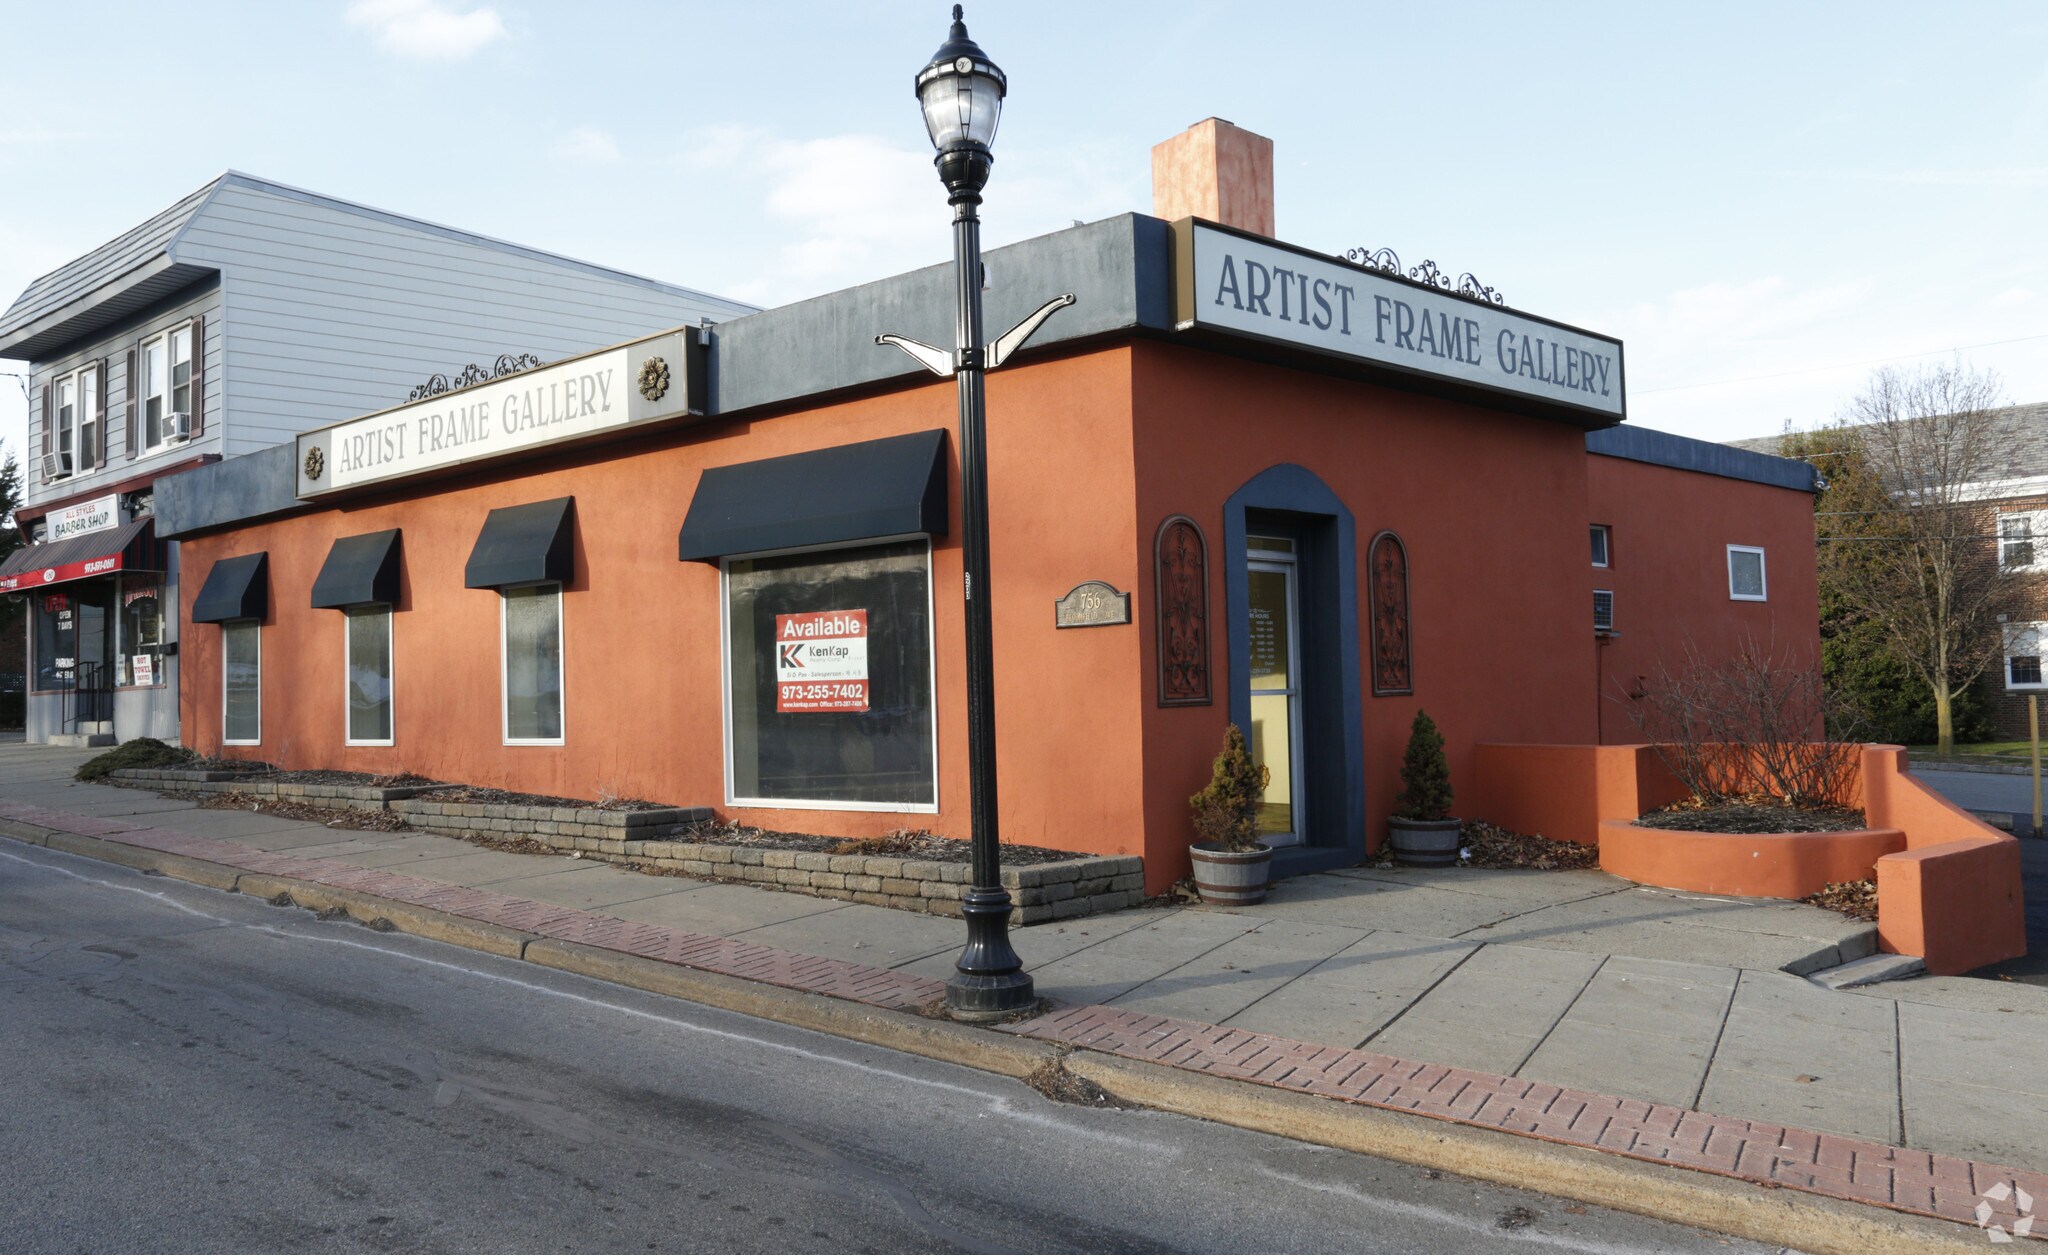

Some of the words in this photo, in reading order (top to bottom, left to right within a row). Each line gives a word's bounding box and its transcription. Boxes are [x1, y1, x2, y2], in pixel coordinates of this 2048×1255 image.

[1214, 254, 1355, 336] ARTIST
[1374, 294, 1482, 367] FRAME
[1496, 328, 1612, 397] GALLERY
[339, 423, 407, 473] ARTIST
[418, 401, 490, 455] FRAME
[502, 368, 614, 435] GALLERY
[66, 510, 75, 519] ALL
[76, 504, 96, 517] STYLES
[55, 517, 86, 538] BARBER
[88, 511, 109, 528] SHOP
[1081, 591, 1101, 610] 756
[59, 610, 72, 620] OPEN
[61, 621, 73, 630] DAYS
[783, 616, 860, 638] Available
[809, 645, 849, 659] KenKap
[55, 657, 75, 668] PARKING
[782, 684, 863, 700] 973-255-7402
